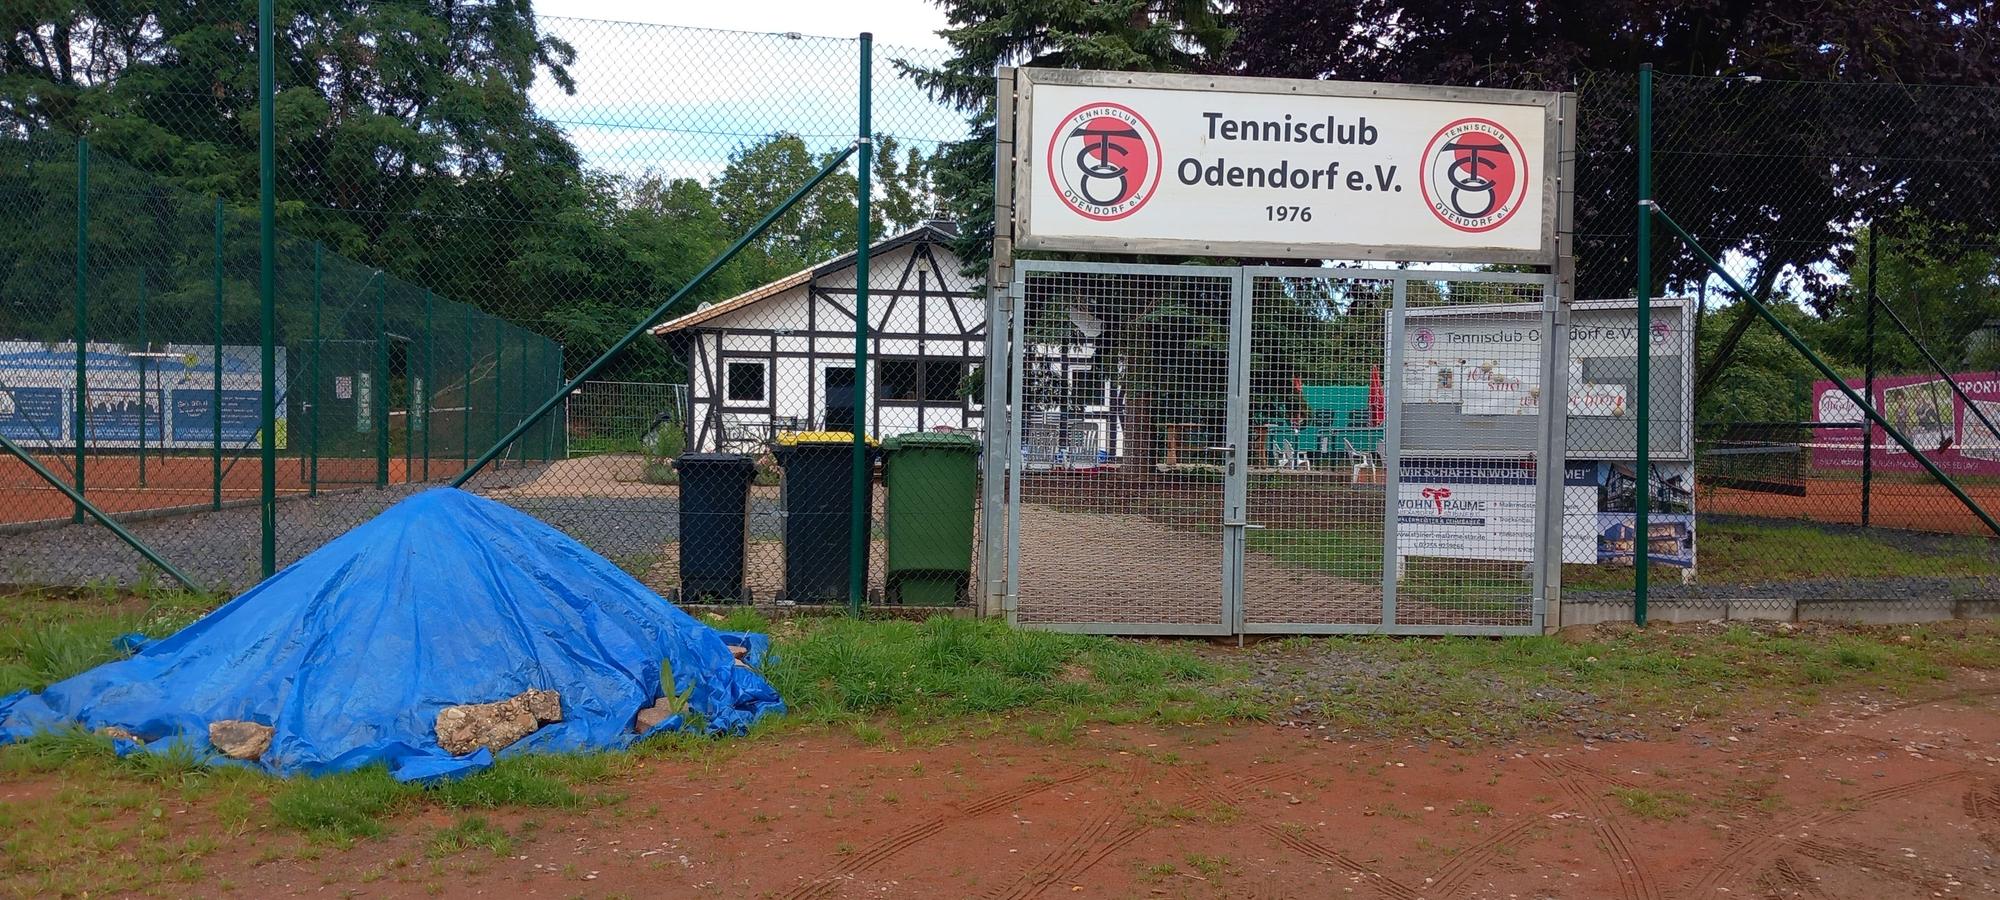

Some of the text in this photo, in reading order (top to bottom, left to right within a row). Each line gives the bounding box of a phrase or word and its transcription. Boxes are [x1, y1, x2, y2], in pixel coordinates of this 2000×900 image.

[1074, 108, 1137, 125] TENNISCLUB
[1203, 112, 1378, 146] Tennisclub
[1444, 124, 1505, 141] TENNISCLUB
[1178, 157, 1402, 192] Odendorf e.V.
[1064, 190, 1125, 215] ODENDORF
[1266, 206, 1312, 222] 1976
[1435, 202, 1493, 227] ODENDORF
[1447, 330, 1522, 343] Tennisclub
[1957, 381, 2000, 393] SPORT
